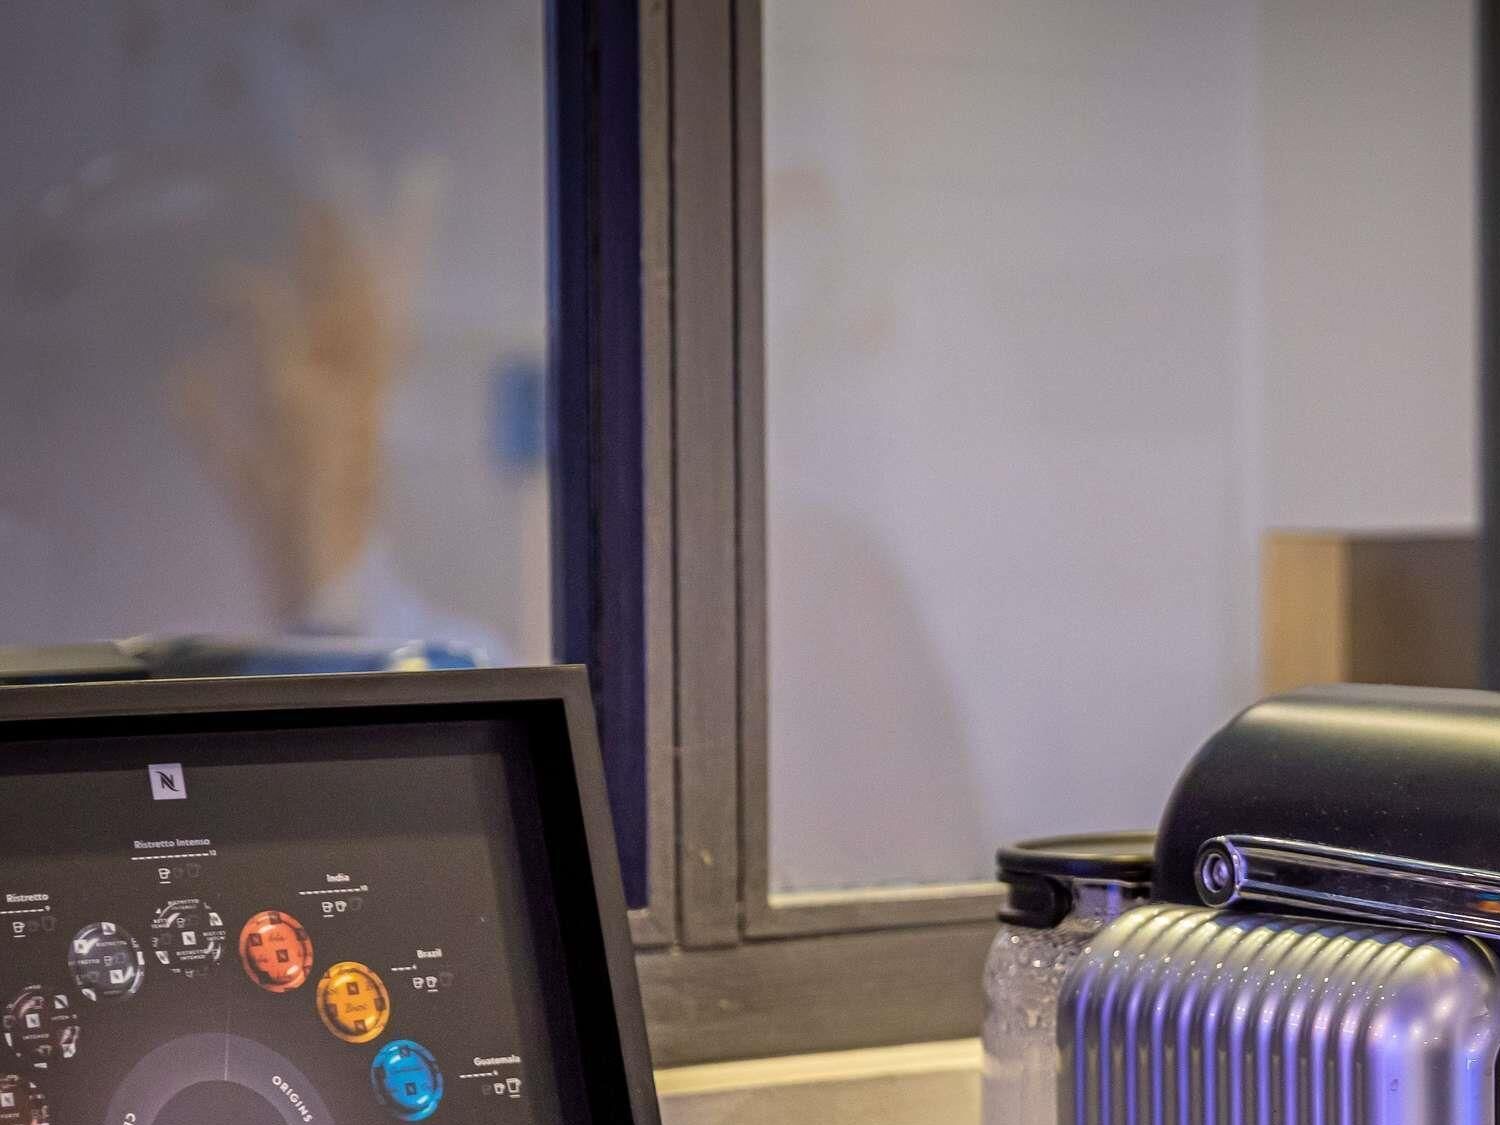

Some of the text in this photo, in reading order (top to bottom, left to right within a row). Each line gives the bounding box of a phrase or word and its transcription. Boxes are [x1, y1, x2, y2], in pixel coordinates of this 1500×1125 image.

[133, 838, 210, 849] Ristretto Intenso
[326, 872, 350, 882] India
[6, 893, 50, 903] Ristretto
[416, 947, 442, 959] Brazil
[473, 1054, 521, 1067] Guatemala
[271, 1075, 313, 1123] ORIGINS
